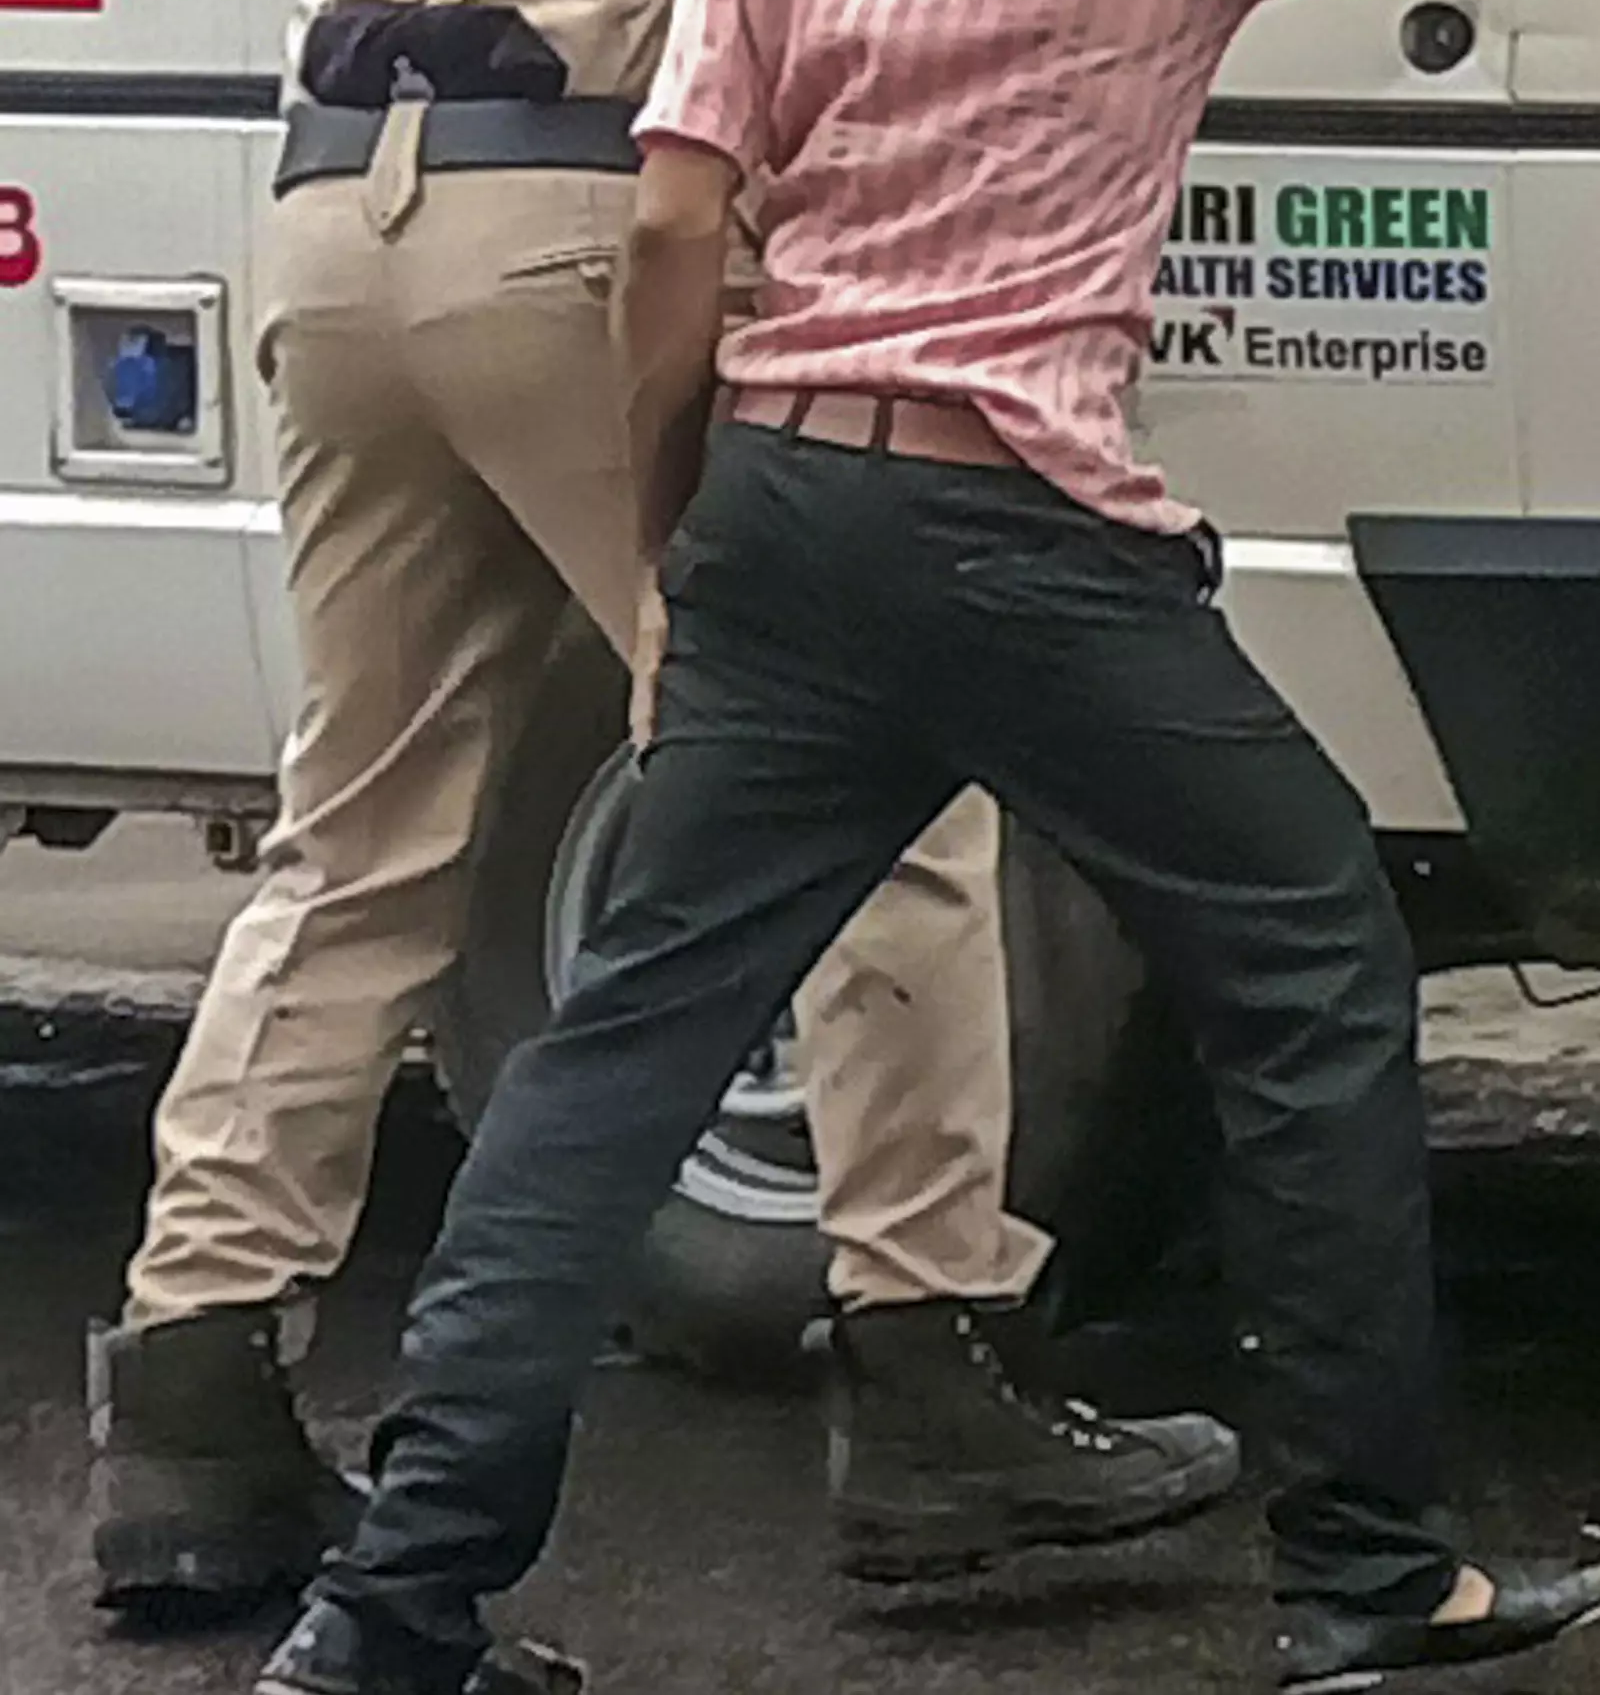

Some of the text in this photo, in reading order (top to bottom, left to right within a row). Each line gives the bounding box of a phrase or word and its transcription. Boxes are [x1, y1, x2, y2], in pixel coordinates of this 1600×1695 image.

[1165, 185, 1490, 250] RI GREEN
[1150, 255, 1487, 303] ALTH SERVICES
[1147, 320, 1487, 381] VK Enterprise
